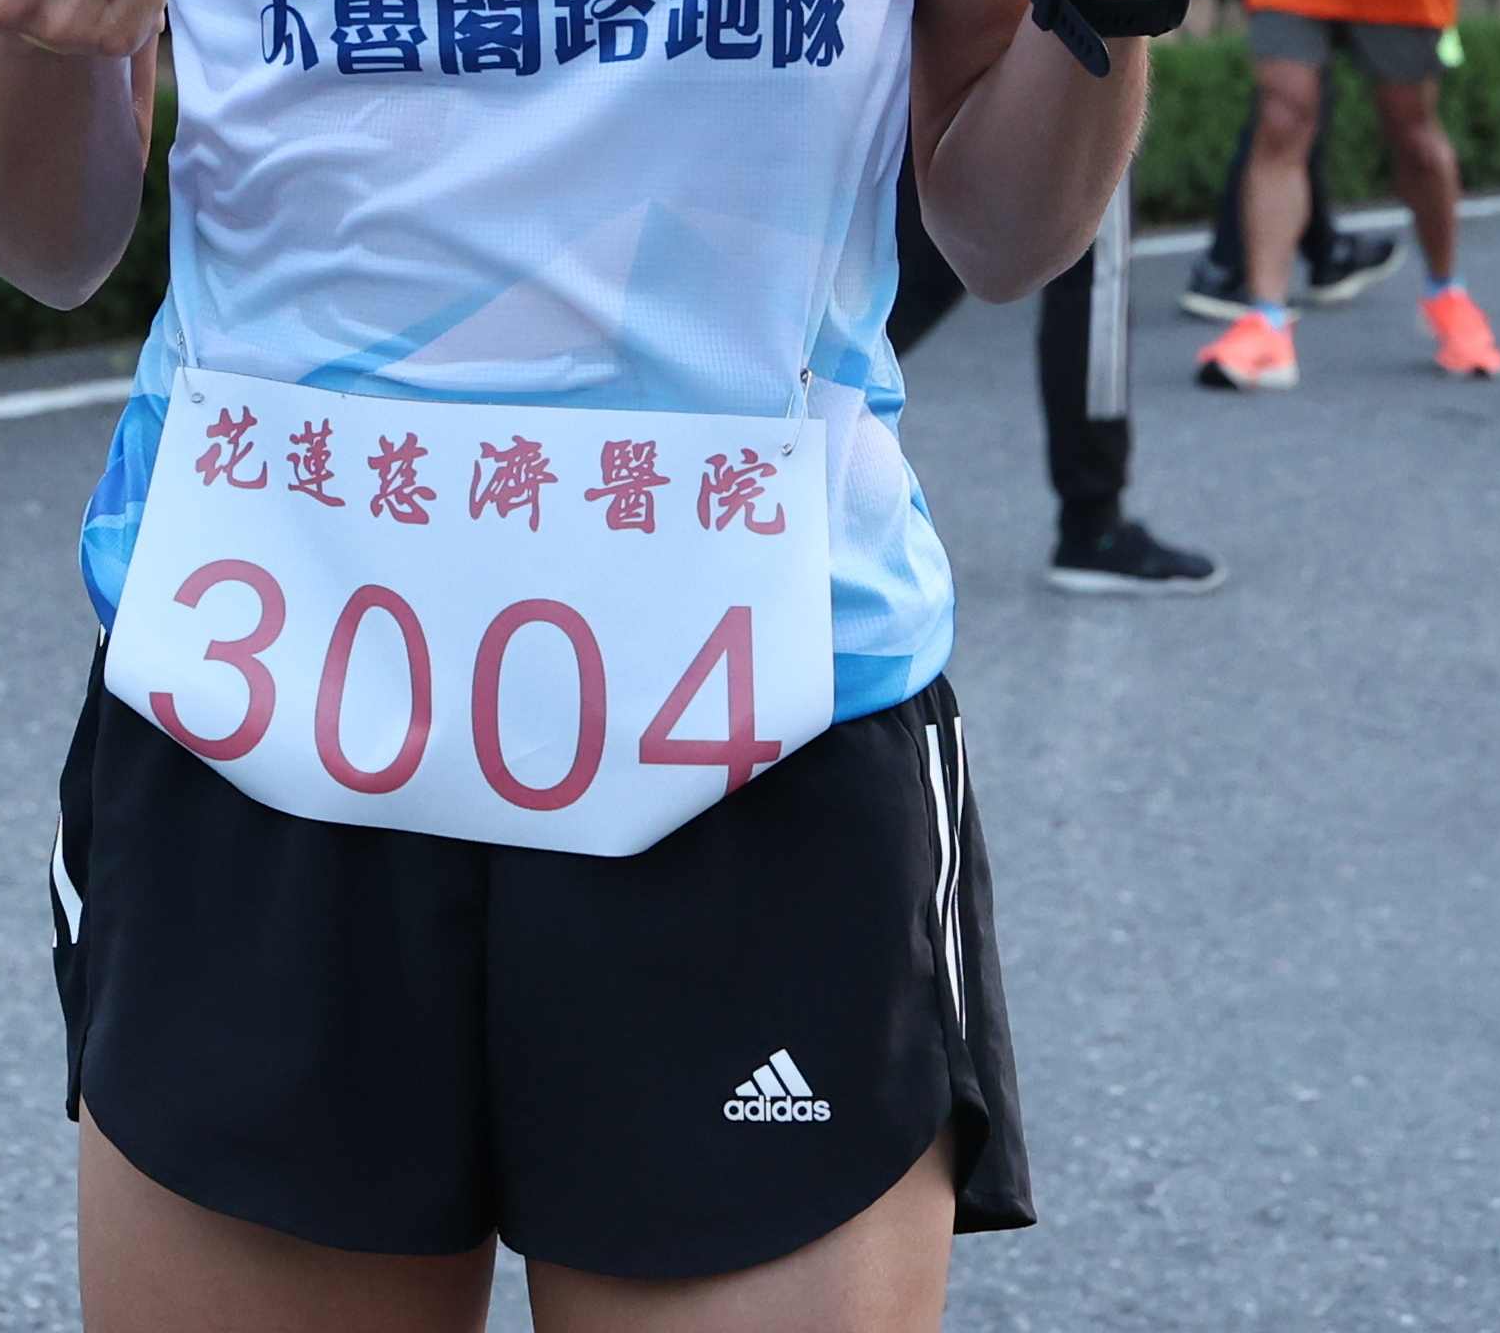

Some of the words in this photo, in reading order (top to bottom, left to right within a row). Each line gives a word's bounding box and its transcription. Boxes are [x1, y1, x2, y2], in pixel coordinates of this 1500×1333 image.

[194, 404, 788, 536] 花蓮慈濟醫院
[147, 558, 784, 813] 3004
[722, 1094, 832, 1123] adidas
